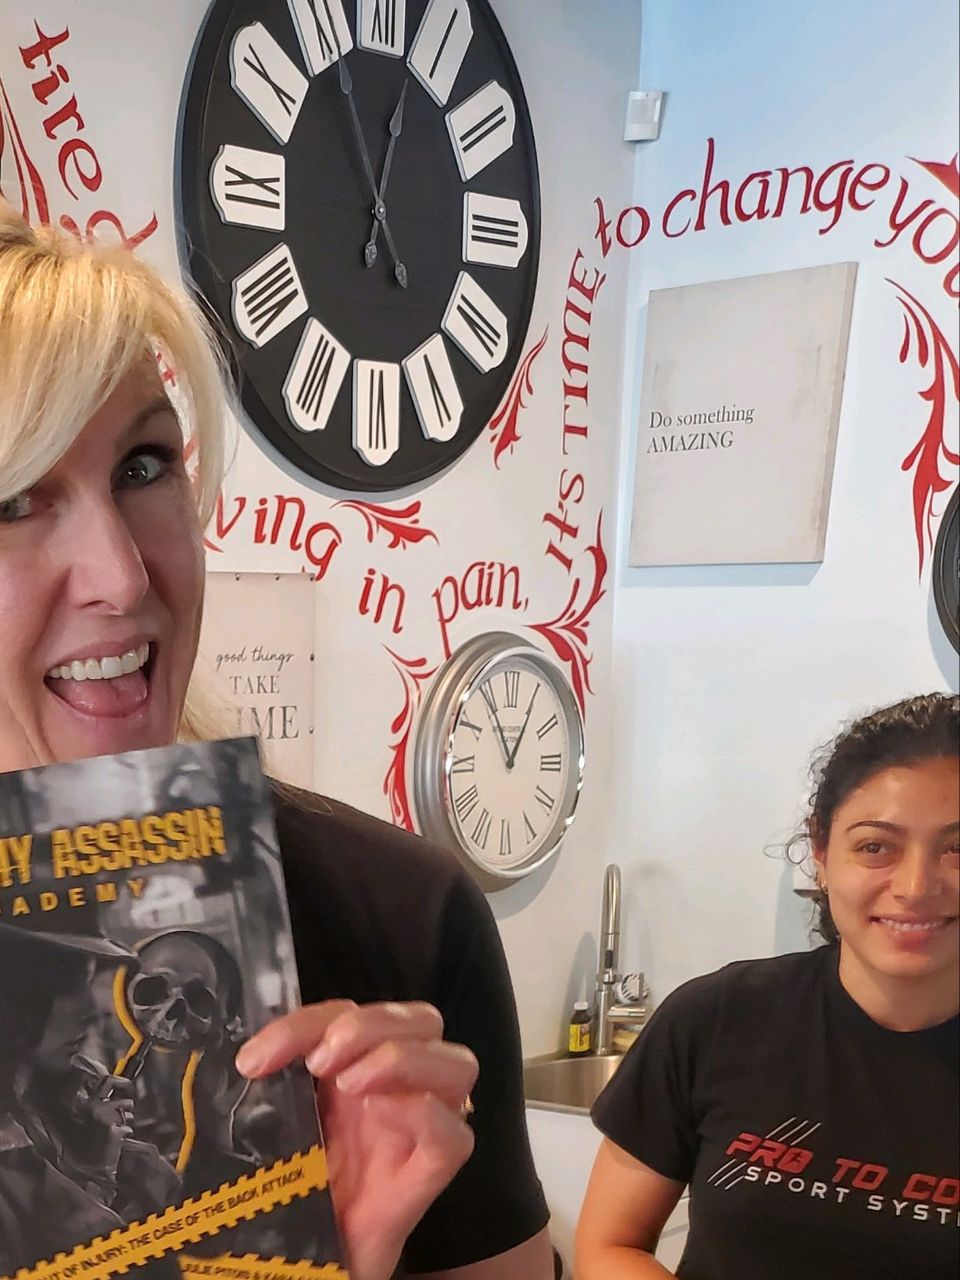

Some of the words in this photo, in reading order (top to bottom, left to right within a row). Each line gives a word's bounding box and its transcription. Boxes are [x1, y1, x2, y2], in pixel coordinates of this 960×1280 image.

[243, 43, 296, 117] X
[562, 248, 606, 455] TIME
[594, 197, 650, 257] to
[662, 137, 890, 235] change
[647, 430, 734, 454] AMAZING
[649, 411, 672, 428] Do
[677, 404, 755, 424] something
[214, 488, 342, 581] ving
[358, 569, 405, 634] in
[216, 646, 247, 672] good
[251, 645, 295, 672] things
[229, 675, 281, 695] TAKE
[222, 705, 299, 740] IME
[51, 805, 225, 878] ASSASSIN
[725, 1132, 813, 1174] PRO
[832, 1157, 889, 1191] TO
[63, 1264, 79, 1279] OF
[81, 1243, 128, 1271] INJURY:
[128, 1231, 152, 1250] THE
[153, 1219, 183, 1240] CASE
[184, 1211, 201, 1227] OF
[203, 1201, 226, 1218] THE
[228, 1189, 258, 1209] BACK
[261, 1167, 305, 1194] ATTACK
[744, 1166, 850, 1203] SPORT
[867, 1194, 959, 1227] SYST
